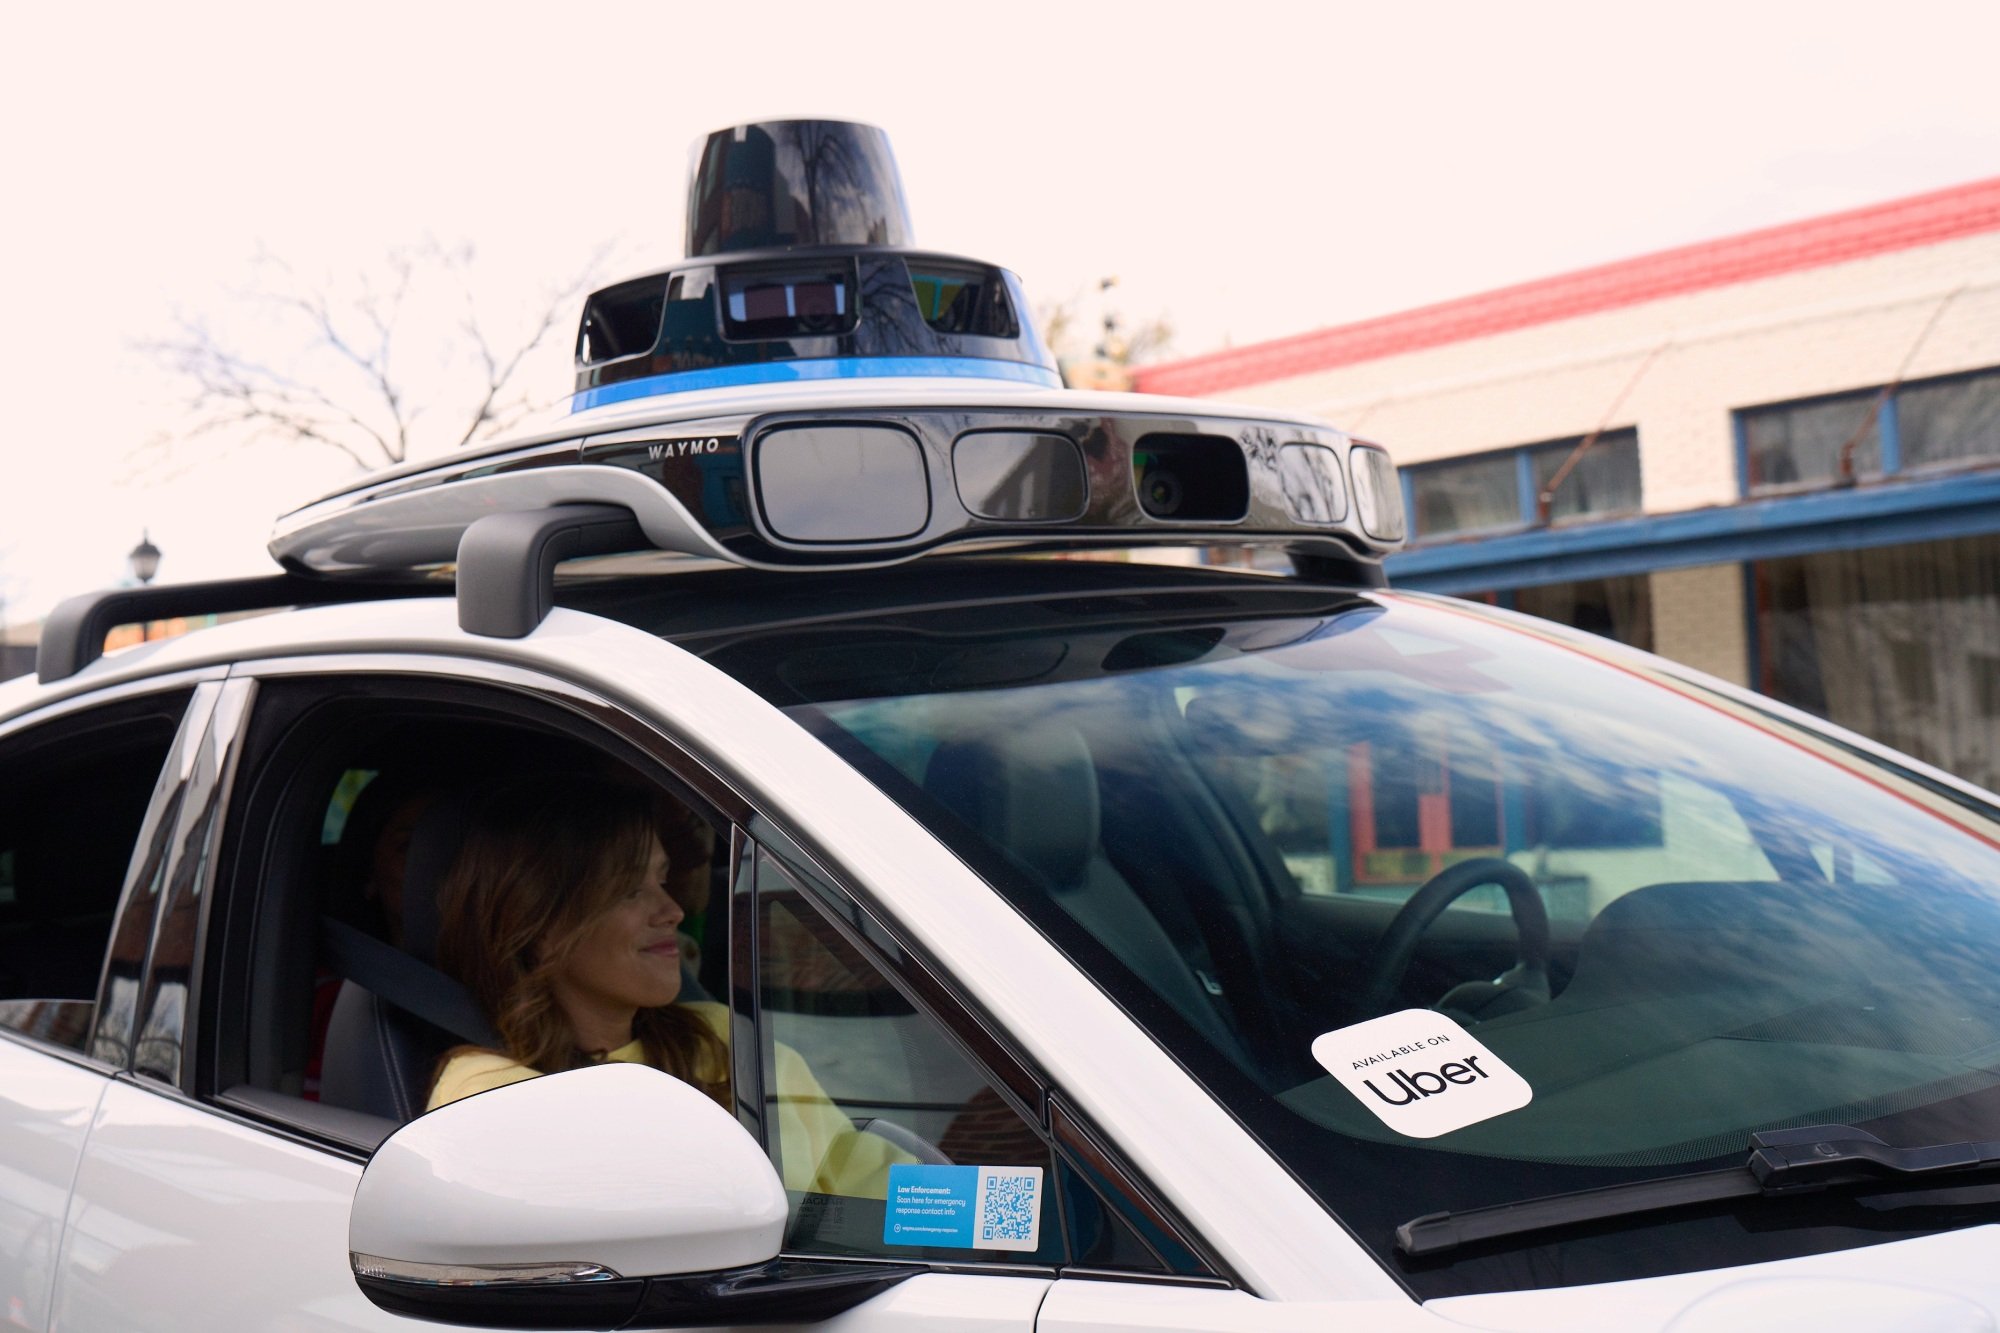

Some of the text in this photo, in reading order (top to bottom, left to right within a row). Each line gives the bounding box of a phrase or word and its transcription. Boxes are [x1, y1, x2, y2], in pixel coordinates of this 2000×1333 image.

[648, 438, 719, 460] WAYMO
[1352, 1034, 1451, 1070] AVAILABLE ON
[1363, 1055, 1489, 1106] Uber
[898, 1185, 951, 1194] Law Enforcement:
[912, 1196, 924, 1204] here
[935, 1199, 966, 1207] emergency
